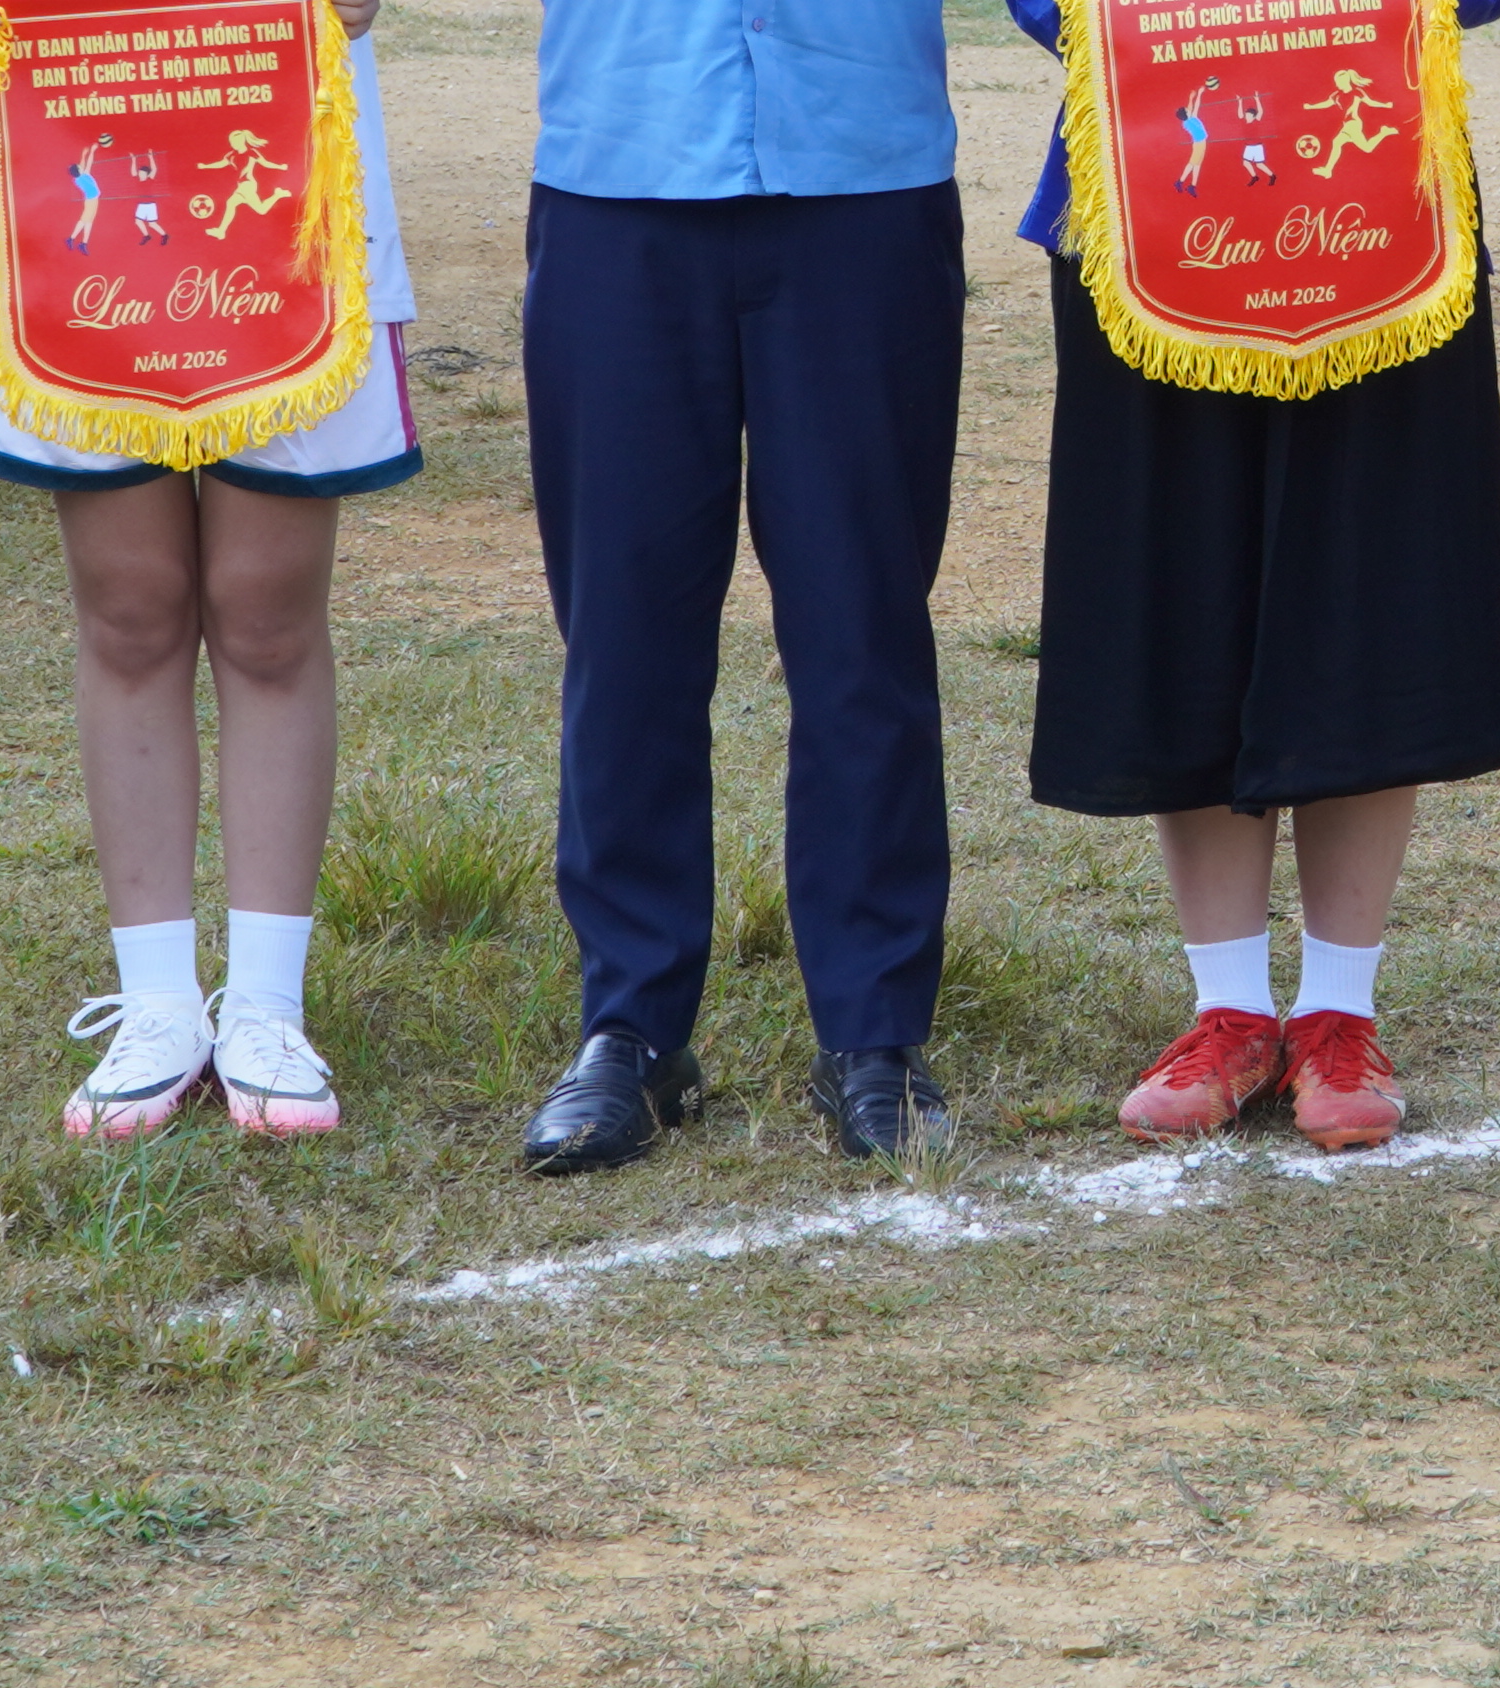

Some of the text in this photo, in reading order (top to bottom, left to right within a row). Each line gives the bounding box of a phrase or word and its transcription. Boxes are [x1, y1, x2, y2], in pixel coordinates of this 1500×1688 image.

[1138, 11, 1173, 34] BAN
[1174, 2, 1196, 30] TỔ
[1199, 2, 1243, 28] CHỨC
[11, 18, 294, 60] ỦY BAN NHÂN DÂN XÃ HỒNG THÁI
[1150, 23, 1377, 64] XÃ HỒNG THÁI NĂM 2026
[32, 50, 279, 88] BAN TỔ CHỨC LỄ HỘI MÙA VÀNG
[44, 83, 273, 119] XÃ HỒNG THÁI NĂM 2026
[1177, 202, 1395, 270] Lưu Niệm
[66, 264, 286, 330] Lưu Niệm
[1245, 284, 1337, 310] NĂM 2026
[133, 349, 227, 373] NĂM 2026
